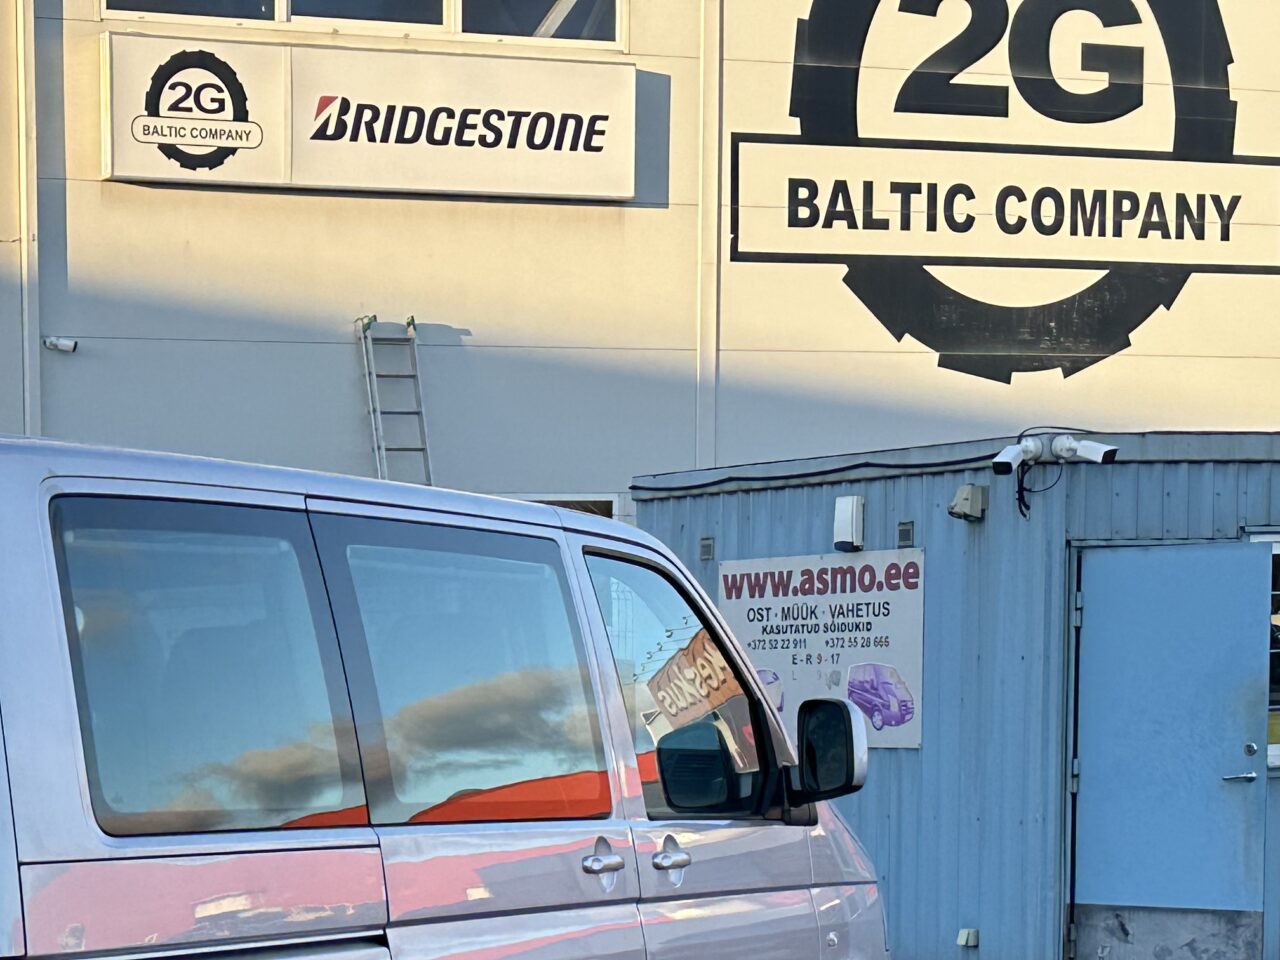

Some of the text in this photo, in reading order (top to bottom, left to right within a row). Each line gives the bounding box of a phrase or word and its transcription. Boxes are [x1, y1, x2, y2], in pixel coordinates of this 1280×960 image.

[894, 0, 1144, 124] 2G
[167, 81, 226, 114] 2G
[142, 124, 252, 142] BALTIC COMPANY
[309, 95, 609, 153] BRIDGESTONE
[787, 177, 1242, 242] BALTIC COMPANY
[722, 561, 920, 600] www.asmo.ee
[747, 601, 890, 622] OST MÜÜK VAHETUS
[761, 623, 820, 635] KASUTATUD
[825, 637, 845, 649] +372
[860, 636, 871, 648] 28
[747, 638, 807, 650] +372 52 22 911
